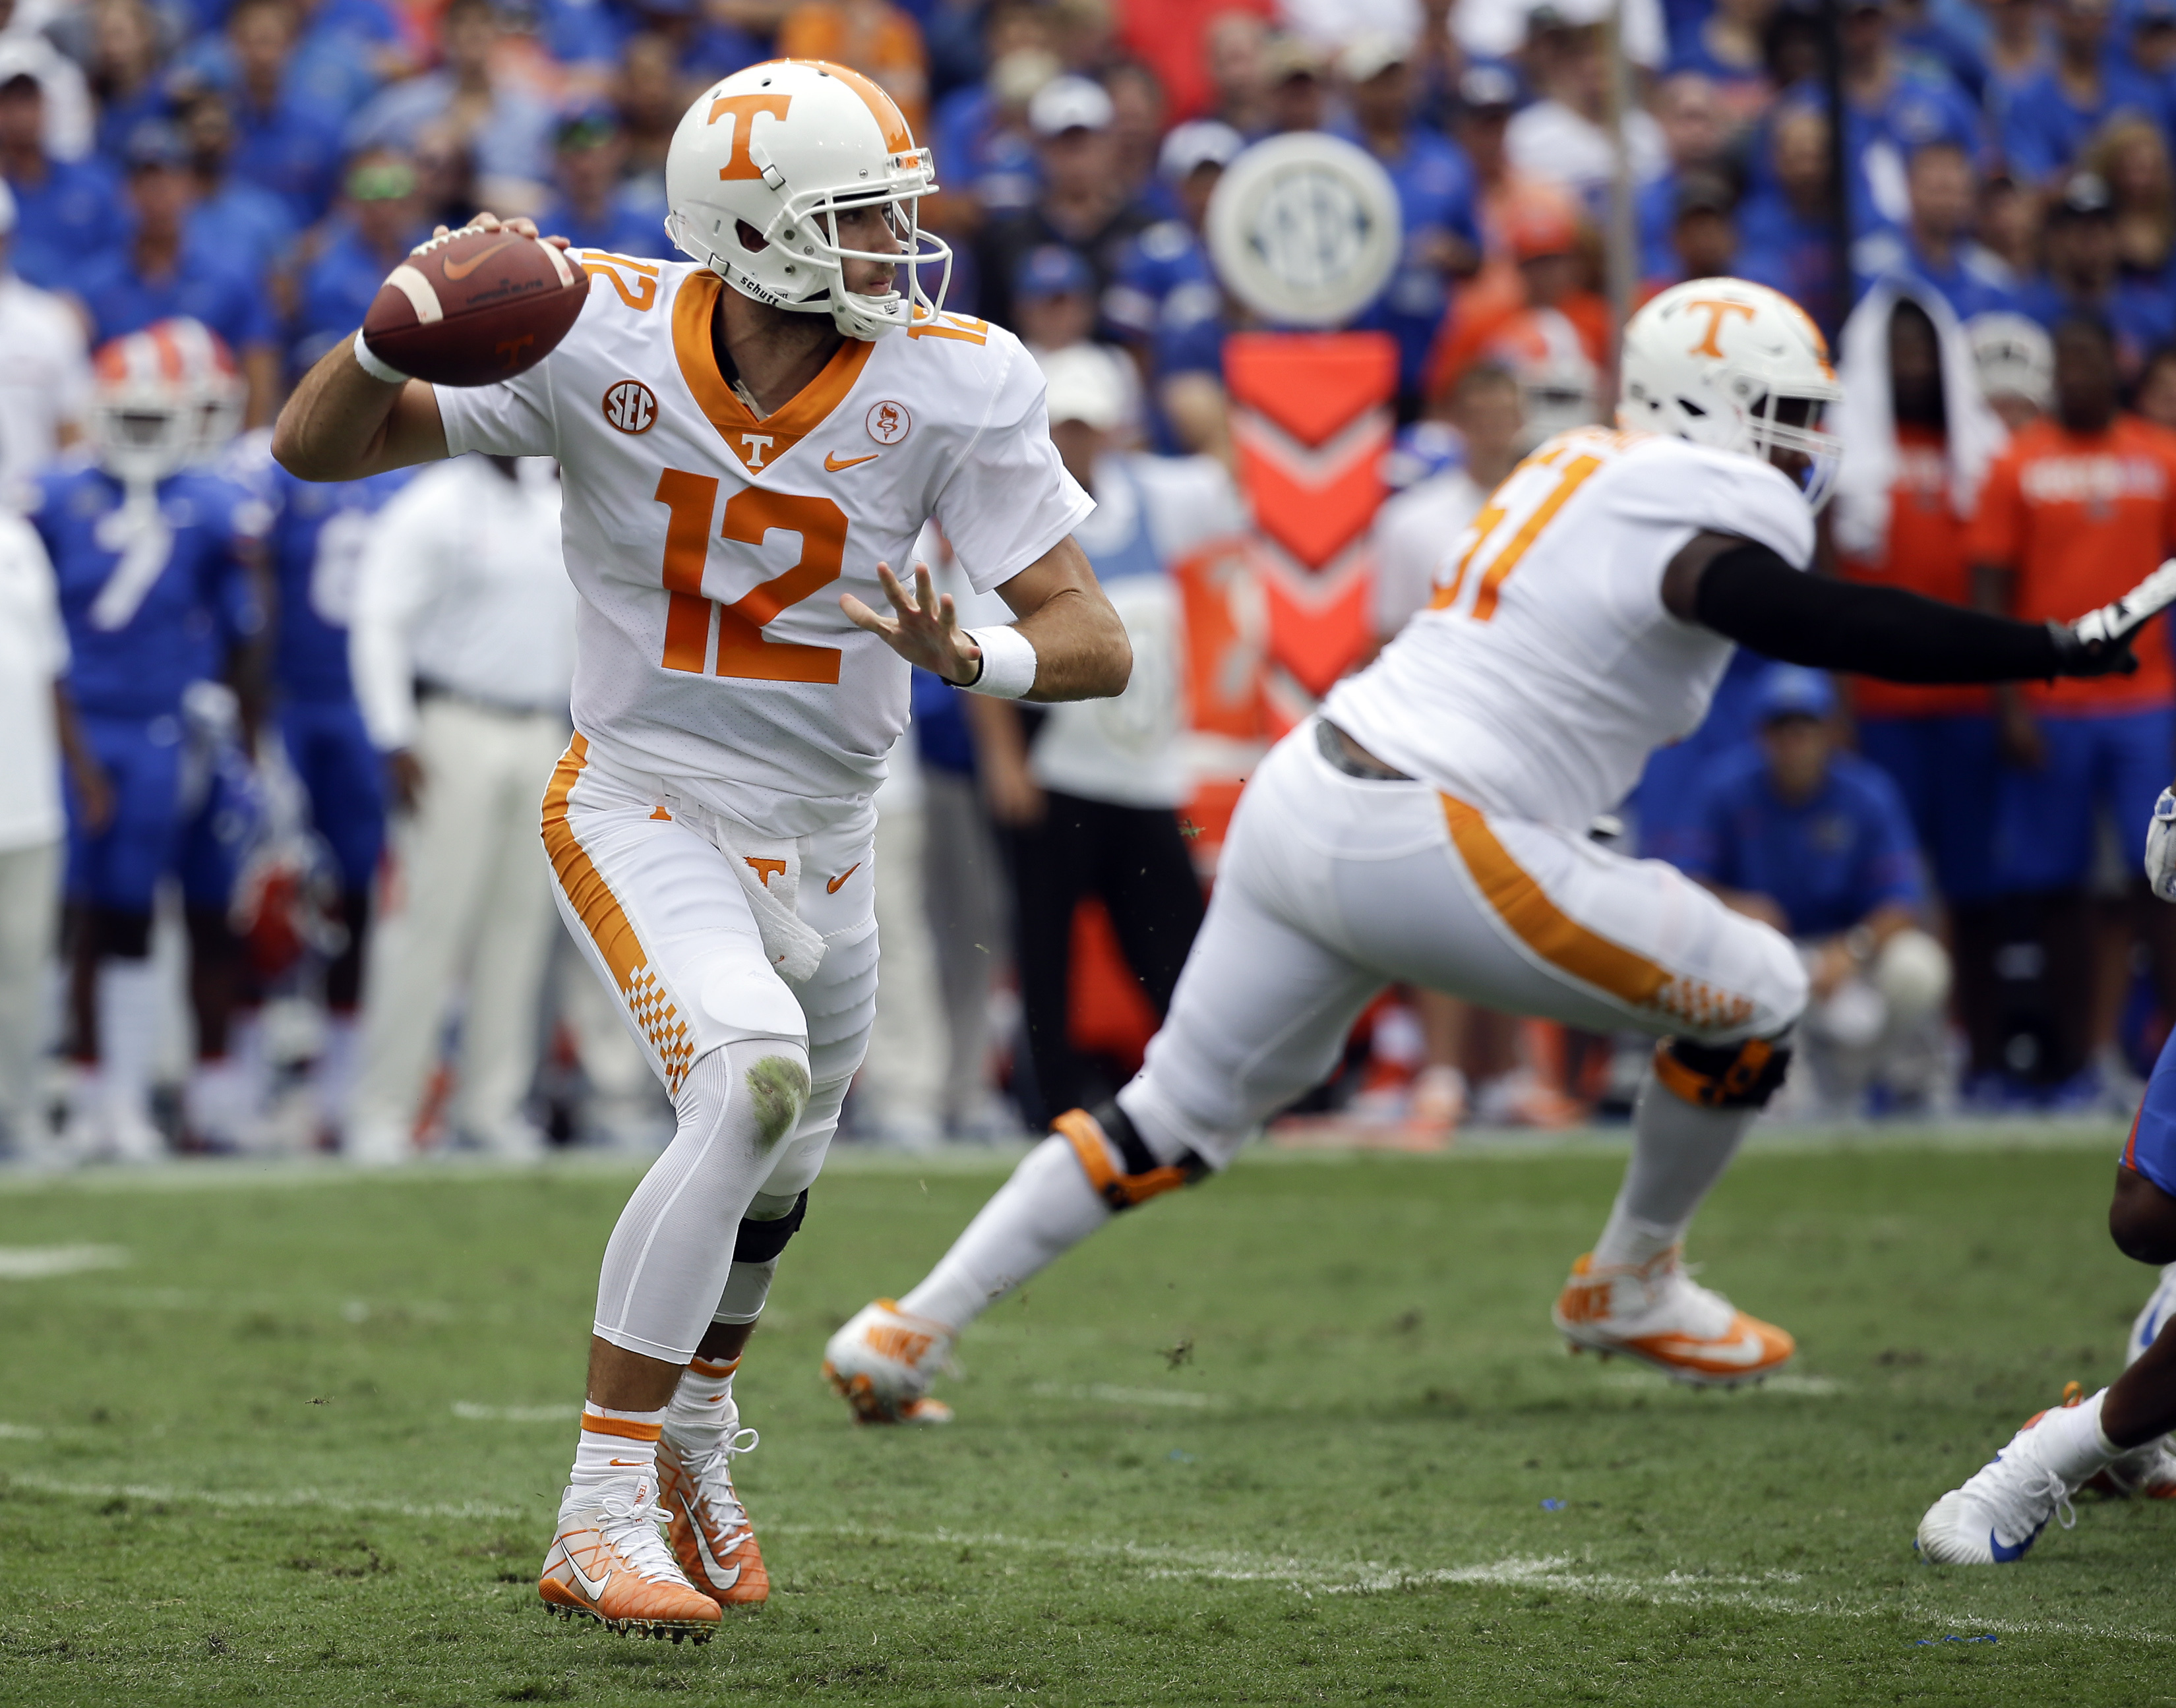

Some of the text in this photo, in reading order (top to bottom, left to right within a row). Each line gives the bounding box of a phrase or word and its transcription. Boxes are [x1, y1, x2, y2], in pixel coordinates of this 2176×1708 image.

[708, 94, 793, 181] T
[581, 252, 659, 311] 12
[740, 276, 779, 307] schutt
[495, 334, 535, 370] T
[1687, 299, 1757, 358] T
[607, 383, 654, 431] SEC
[741, 433, 773, 467] T
[654, 467, 849, 685] 12
